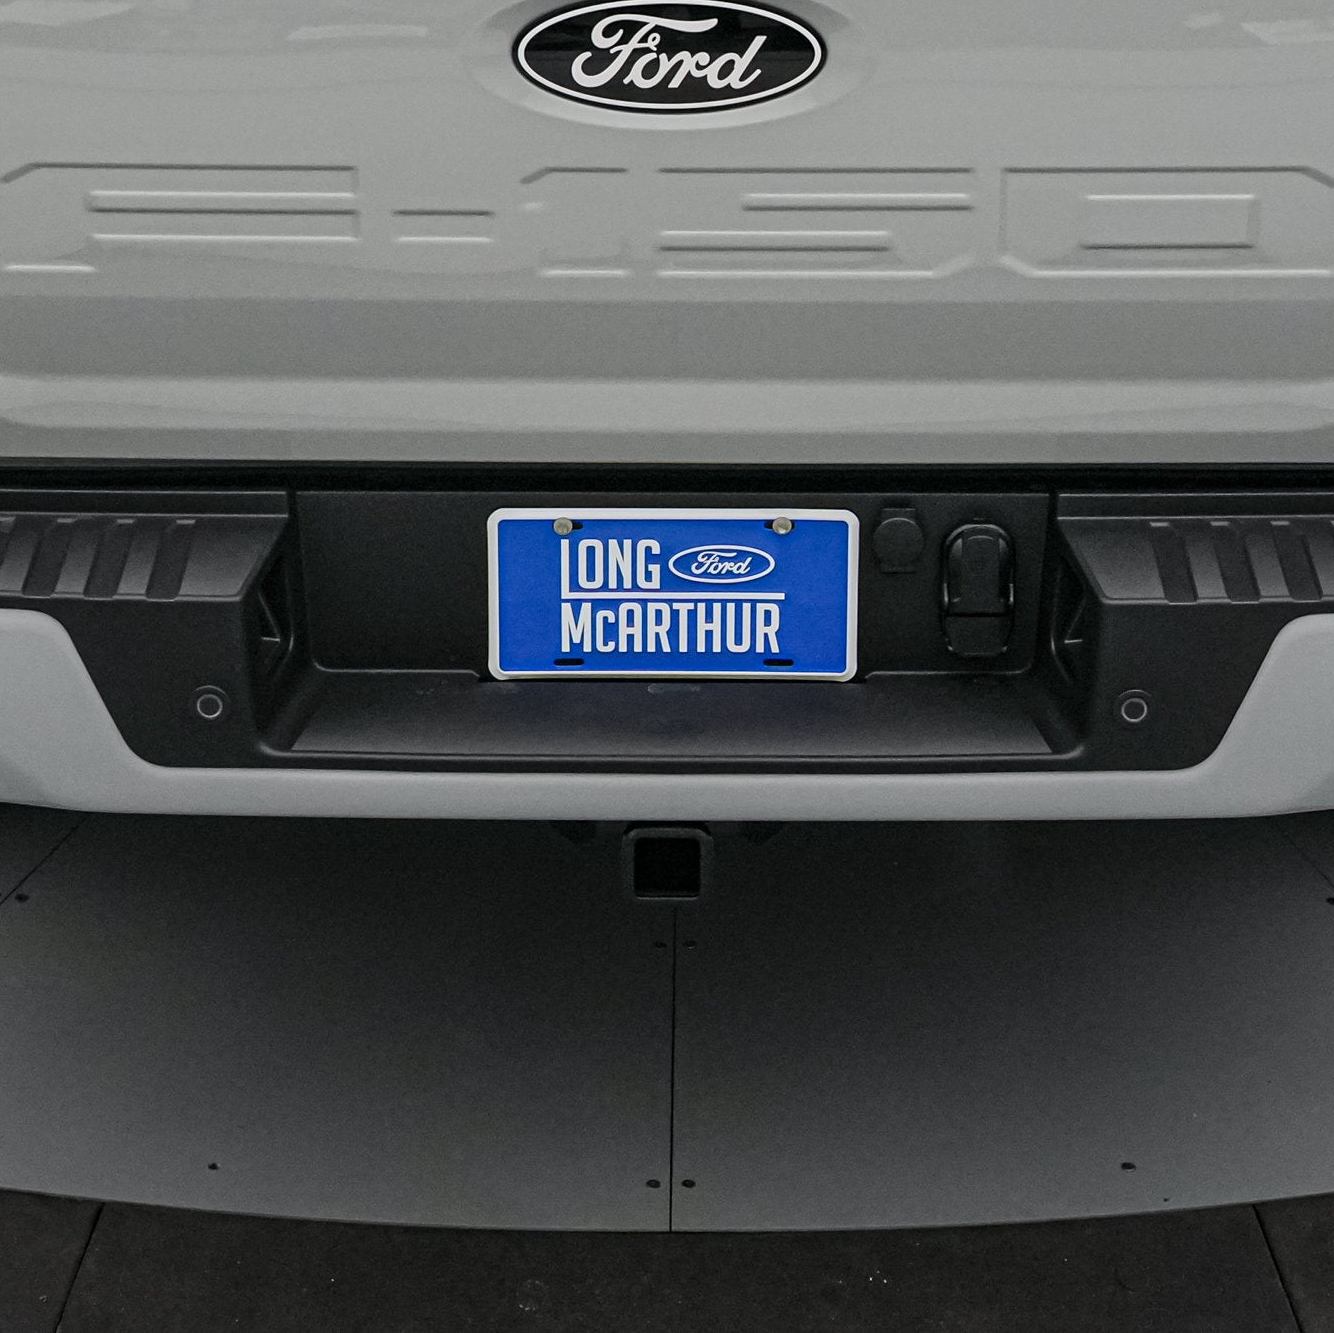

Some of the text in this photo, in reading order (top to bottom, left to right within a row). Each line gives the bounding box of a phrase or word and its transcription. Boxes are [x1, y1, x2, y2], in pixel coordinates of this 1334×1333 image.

[571, 13, 767, 89] Ford
[561, 538, 751, 590] LONG Ford
[561, 602, 780, 654] McARTHUR
